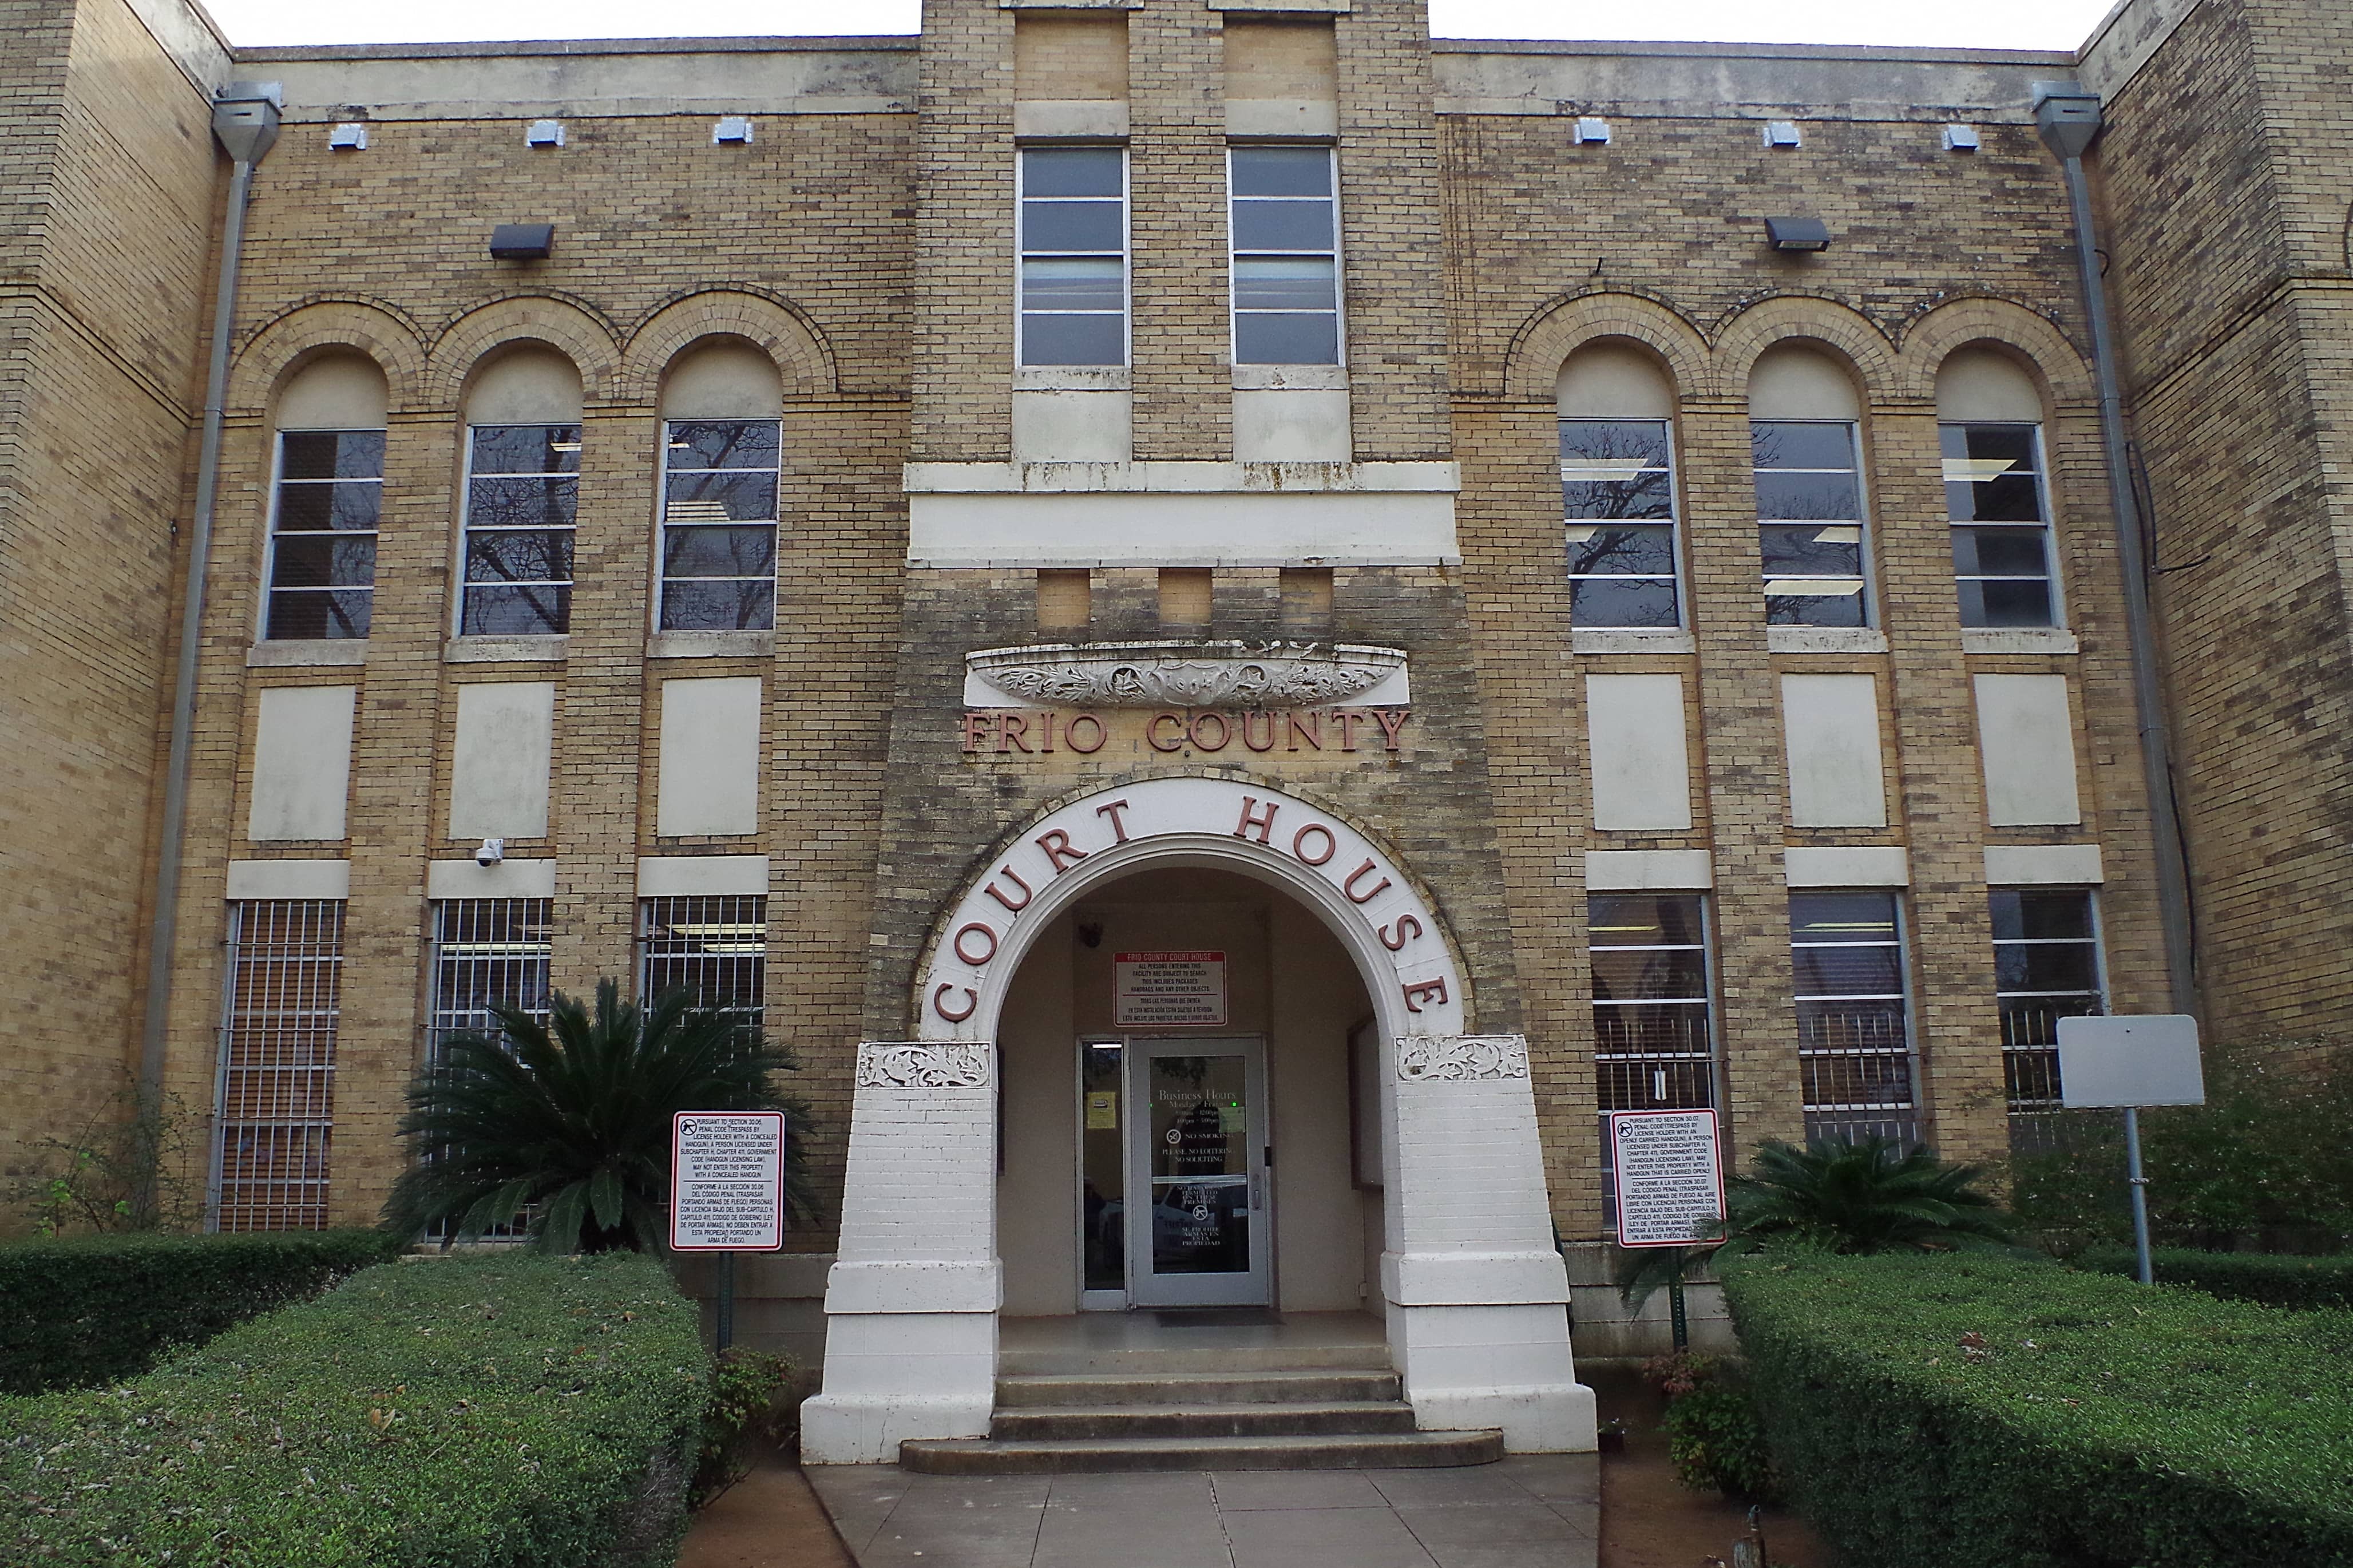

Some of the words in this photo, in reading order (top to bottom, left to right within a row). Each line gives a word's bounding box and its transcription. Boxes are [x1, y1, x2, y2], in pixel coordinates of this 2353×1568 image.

[964, 712, 1107, 753] FRIO
[1147, 711, 1410, 752] COUNTY
[934, 799, 1130, 1021] COURT
[1233, 796, 1448, 1012] HOUSE
[1159, 1090, 1201, 1100] Business
[1206, 1090, 1236, 1100] Hours
